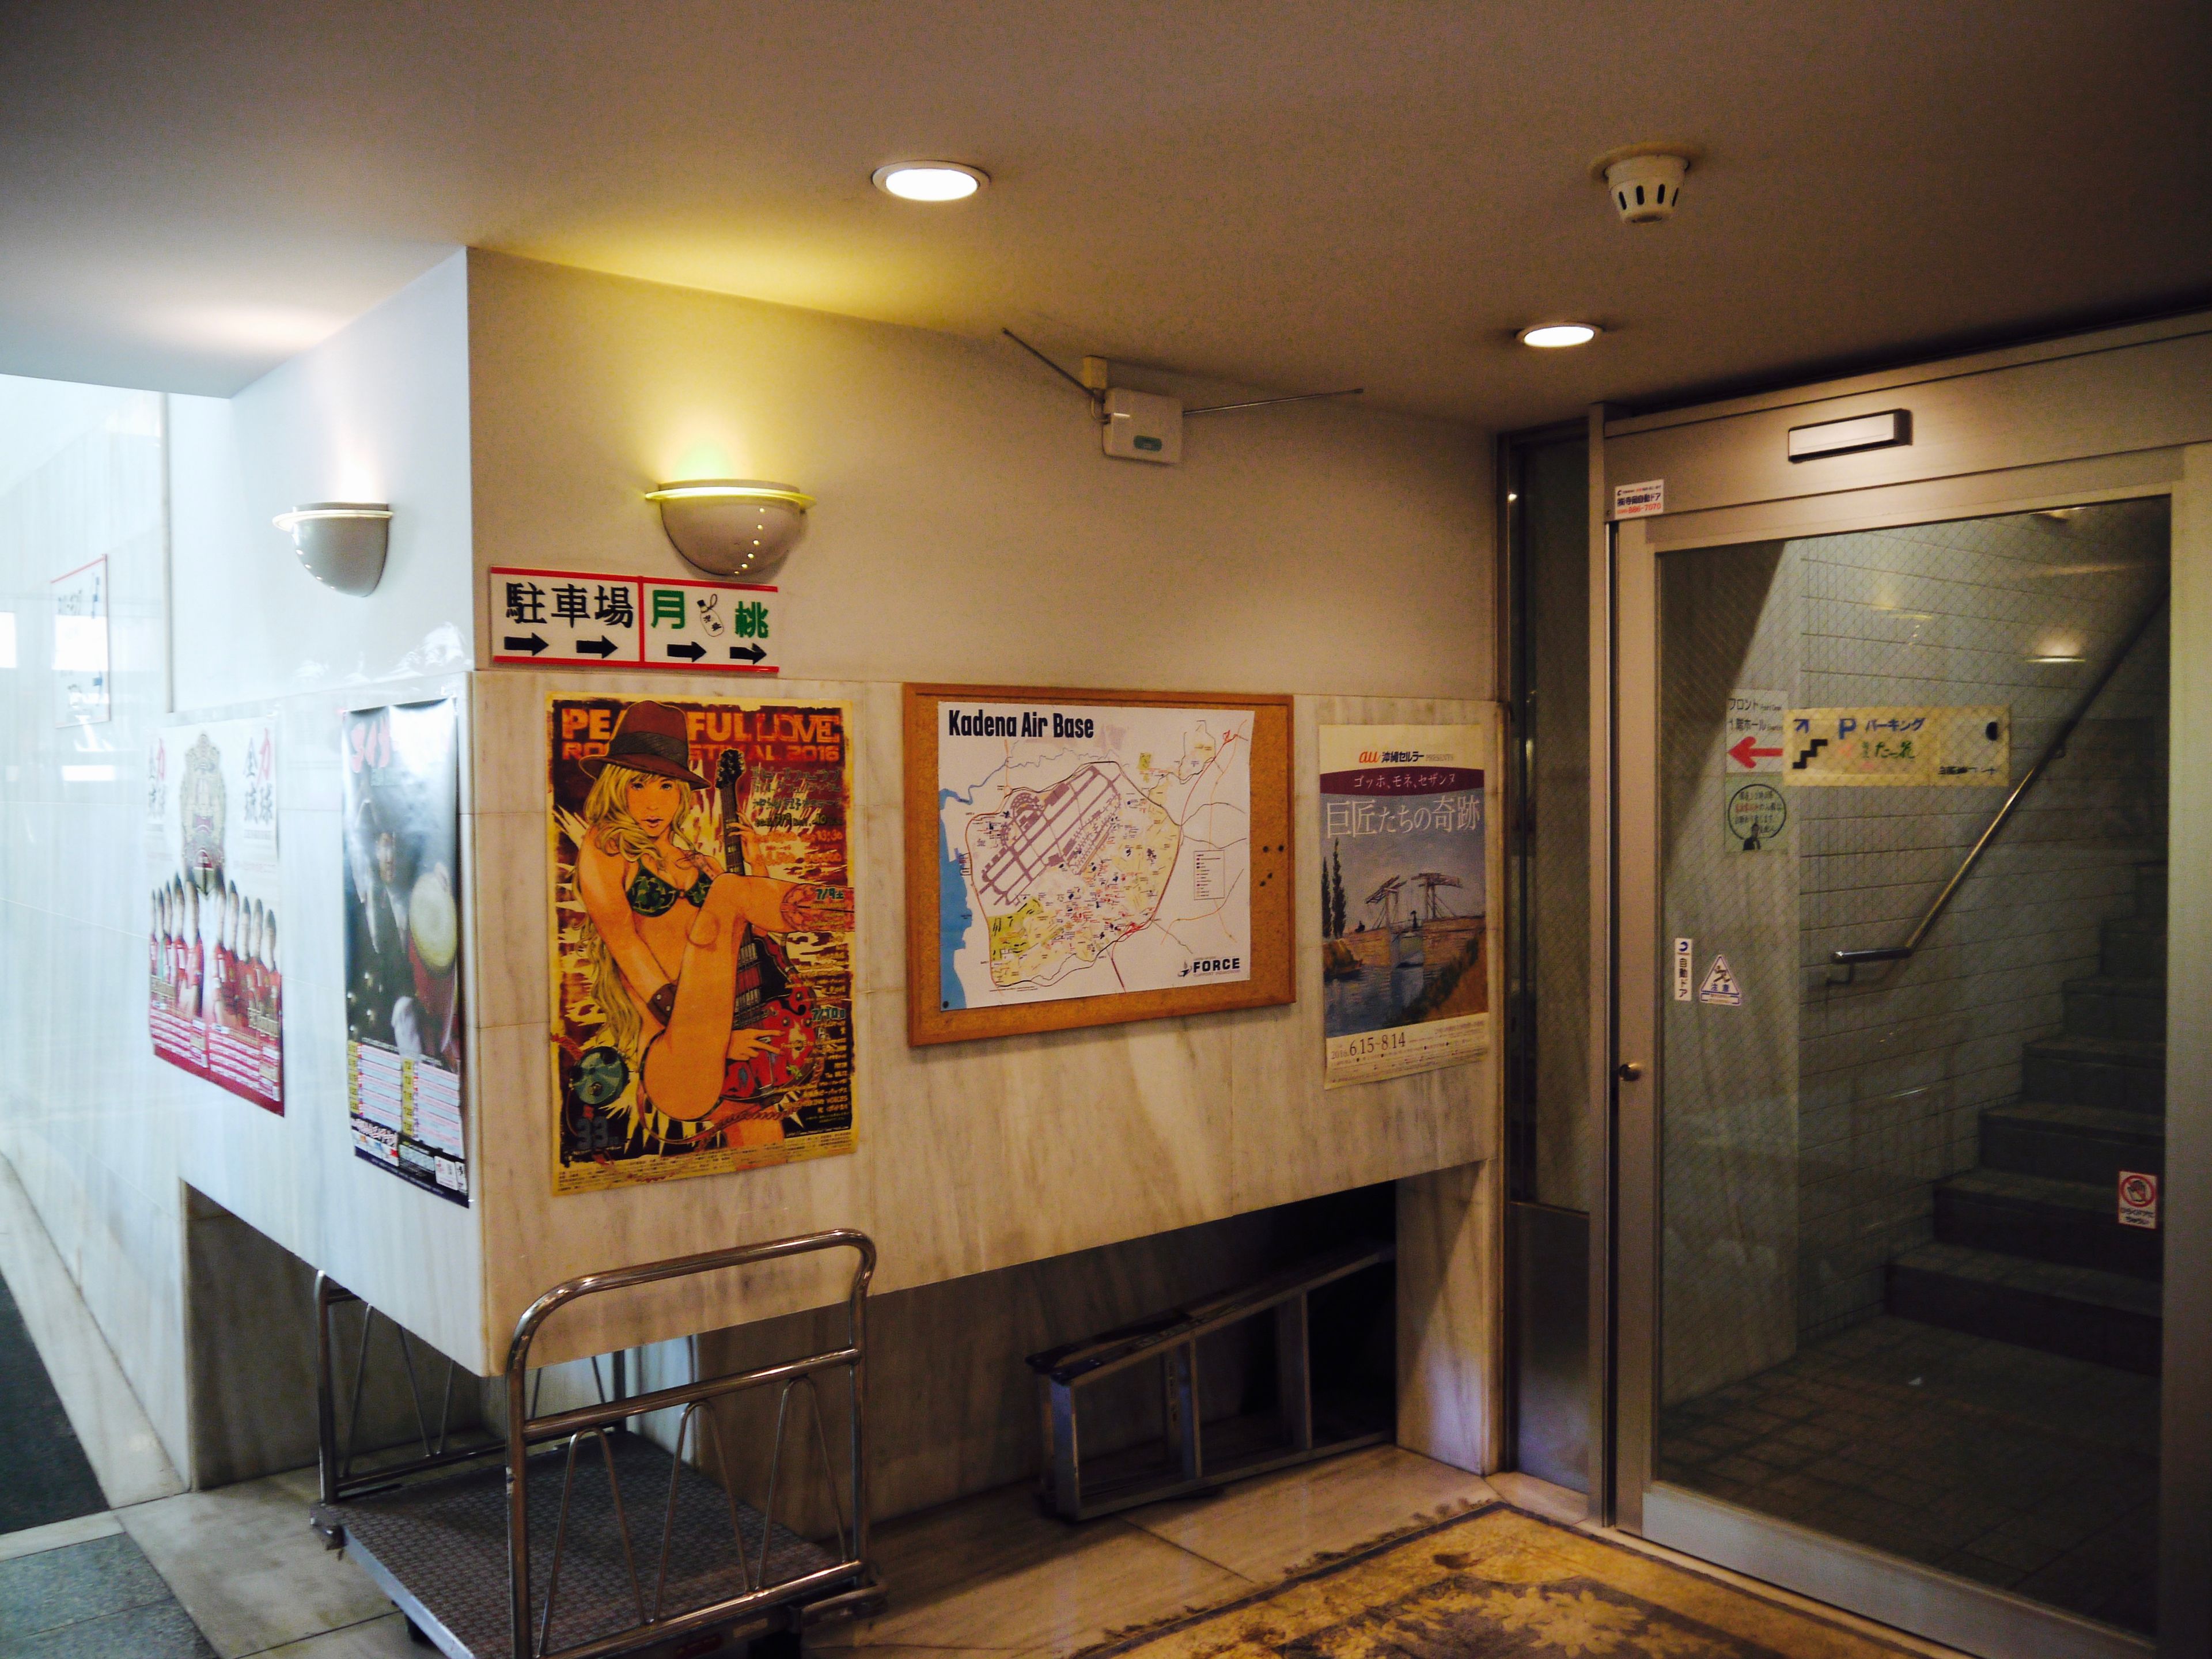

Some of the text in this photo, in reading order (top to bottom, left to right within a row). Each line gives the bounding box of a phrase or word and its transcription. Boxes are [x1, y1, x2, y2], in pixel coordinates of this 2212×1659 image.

[506, 582, 634, 628] 駐車場
[651, 590, 769, 638] 月 桃
[756, 713, 840, 742] LOVE
[949, 709, 1093, 738] Kadena Air Base
[1839, 718, 1857, 740] P
[1865, 718, 1926, 733] パーキング
[786, 745, 839, 762] 2016
[1359, 752, 1379, 763] au
[1326, 795, 1481, 839] 巨匠たちの奇跡
[1193, 958, 1240, 973] FORCE
